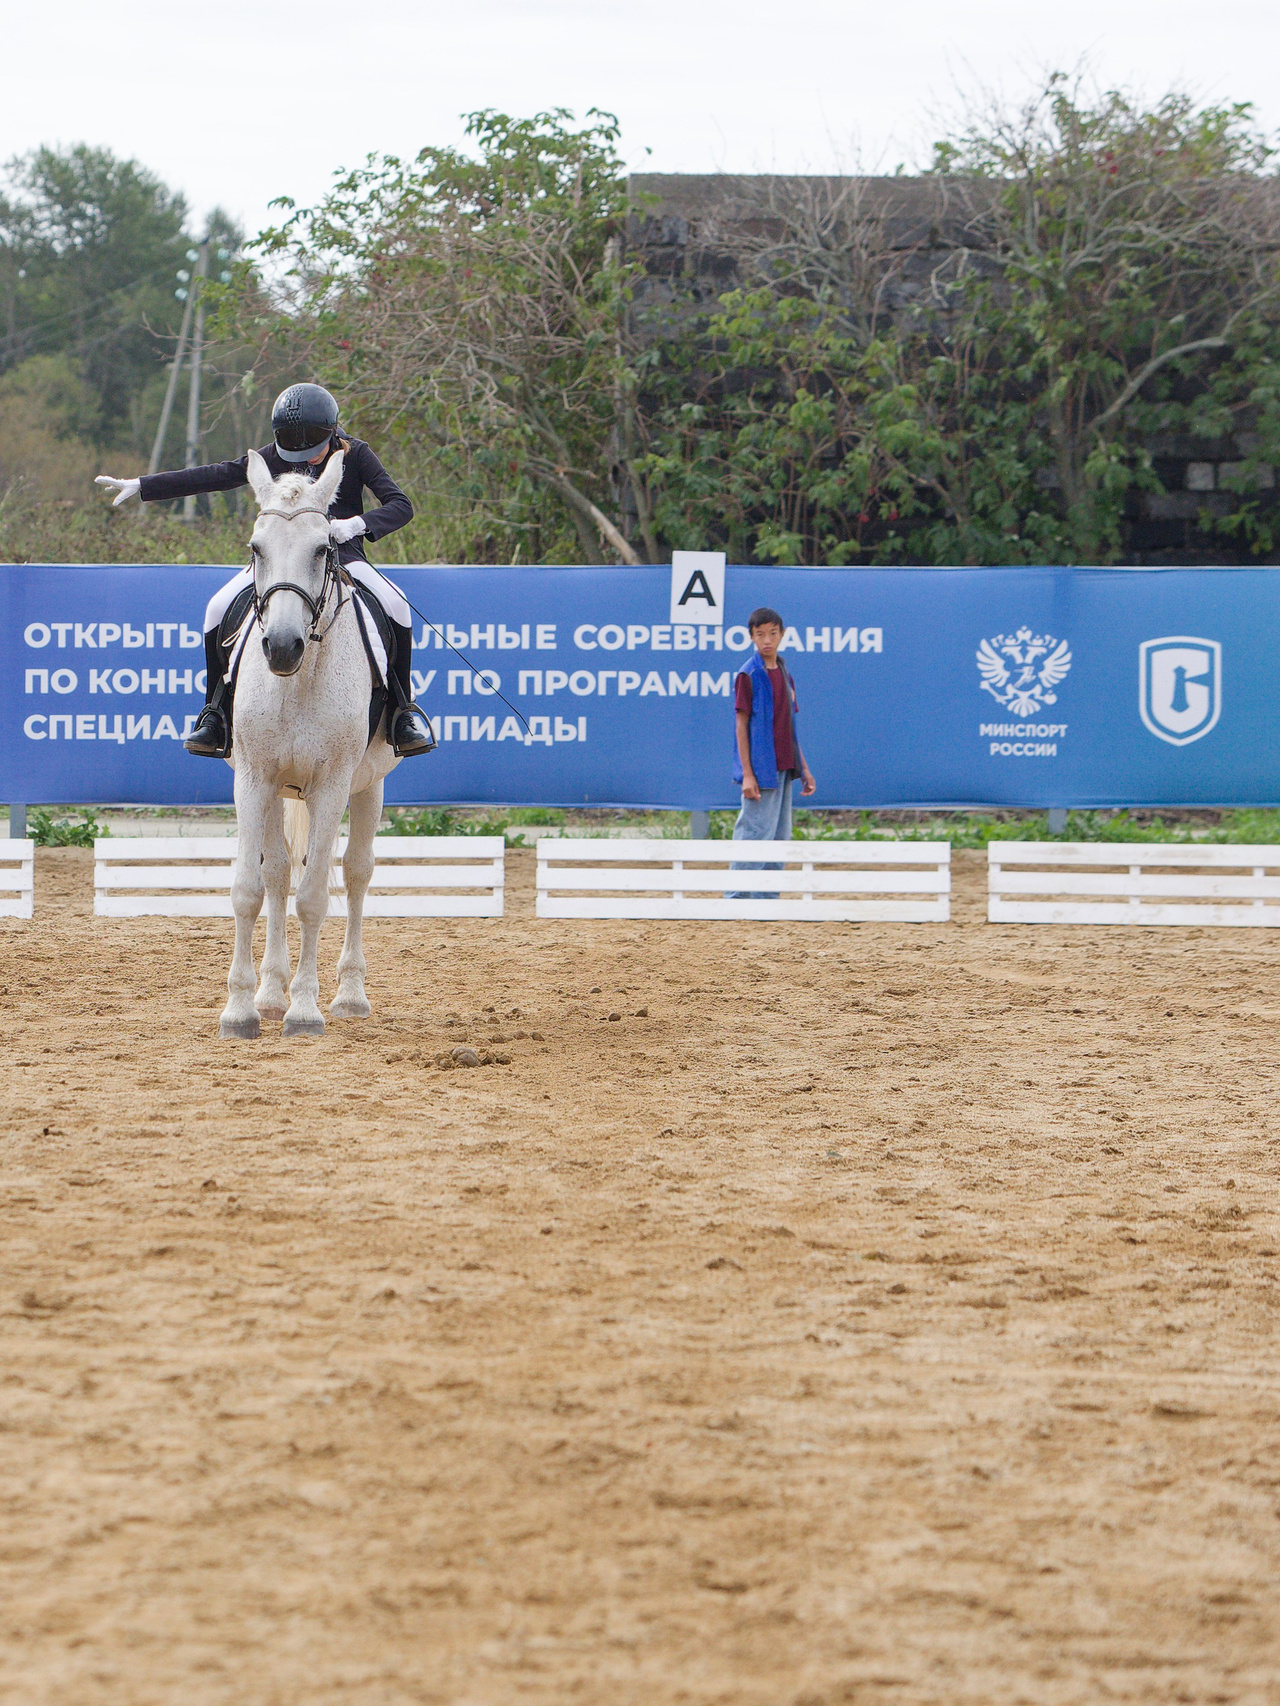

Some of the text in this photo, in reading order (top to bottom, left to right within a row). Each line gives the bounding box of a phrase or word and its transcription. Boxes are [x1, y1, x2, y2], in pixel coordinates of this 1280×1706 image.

[411, 623, 558, 650] ЛЬНЫЕ
[573, 624, 883, 653] СОРЕВНОАНИЯ
[25, 668, 78, 694] ПО
[447, 669, 501, 696] ПО
[518, 669, 737, 698] ПРОГРАММ
[23, 714, 196, 745] СПЕЦИАЛ
[979, 723, 1068, 738] МИНСПОРТ
[989, 742, 1057, 757] РОССИИ
